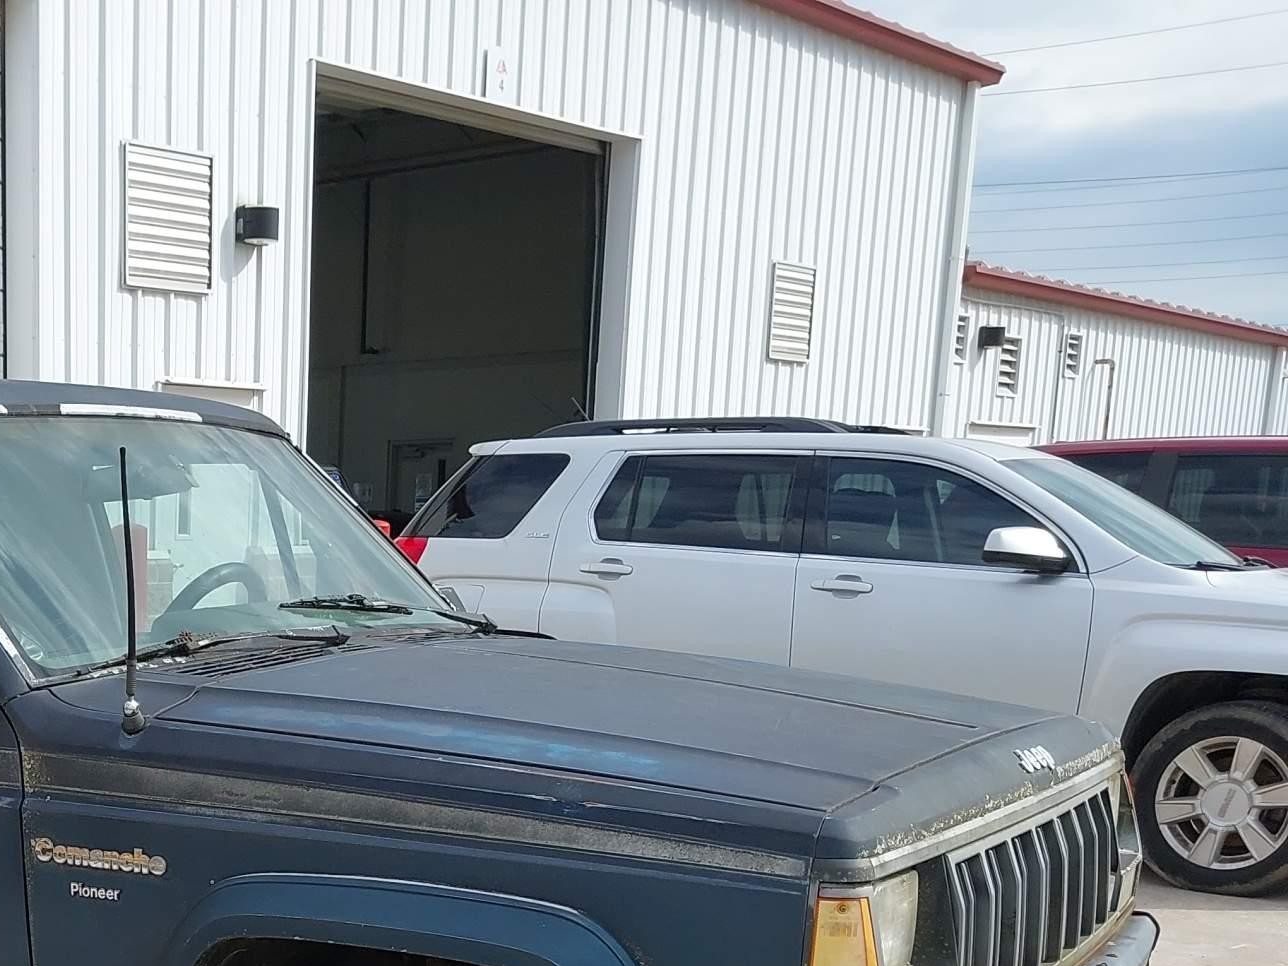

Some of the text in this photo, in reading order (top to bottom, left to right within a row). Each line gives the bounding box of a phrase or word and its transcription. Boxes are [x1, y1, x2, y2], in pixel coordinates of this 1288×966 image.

[1012, 745, 1056, 774] Jeep
[32, 837, 167, 876] Comanche
[70, 881, 120, 901] Pioneer
